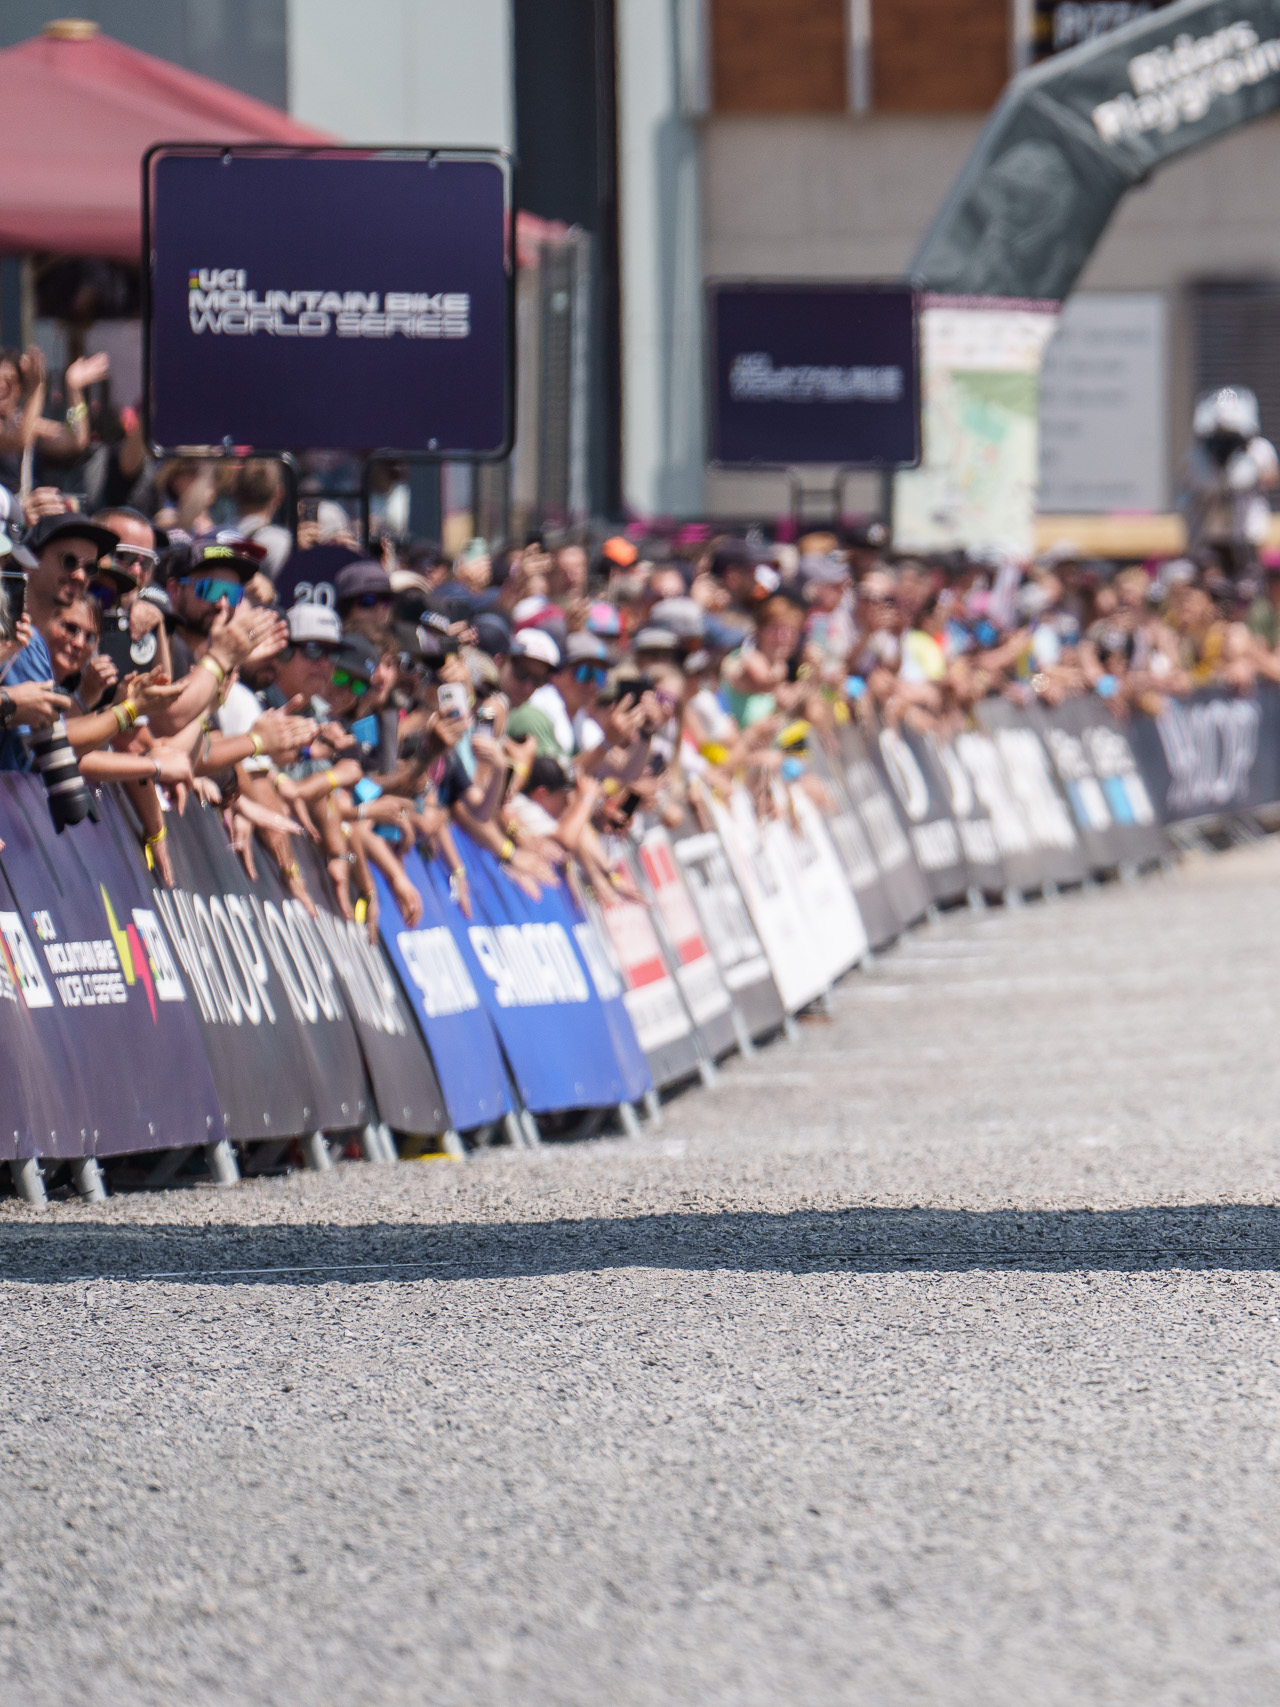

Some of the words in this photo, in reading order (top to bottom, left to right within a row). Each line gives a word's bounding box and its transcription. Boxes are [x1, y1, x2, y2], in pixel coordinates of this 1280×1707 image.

[1127, 20, 1260, 95] Riders
[199, 268, 247, 290] UCI
[188, 289, 379, 315] MOUNTAIN
[384, 291, 470, 314] BIKE
[189, 310, 330, 336] WORLD
[336, 312, 470, 339] SERIES
